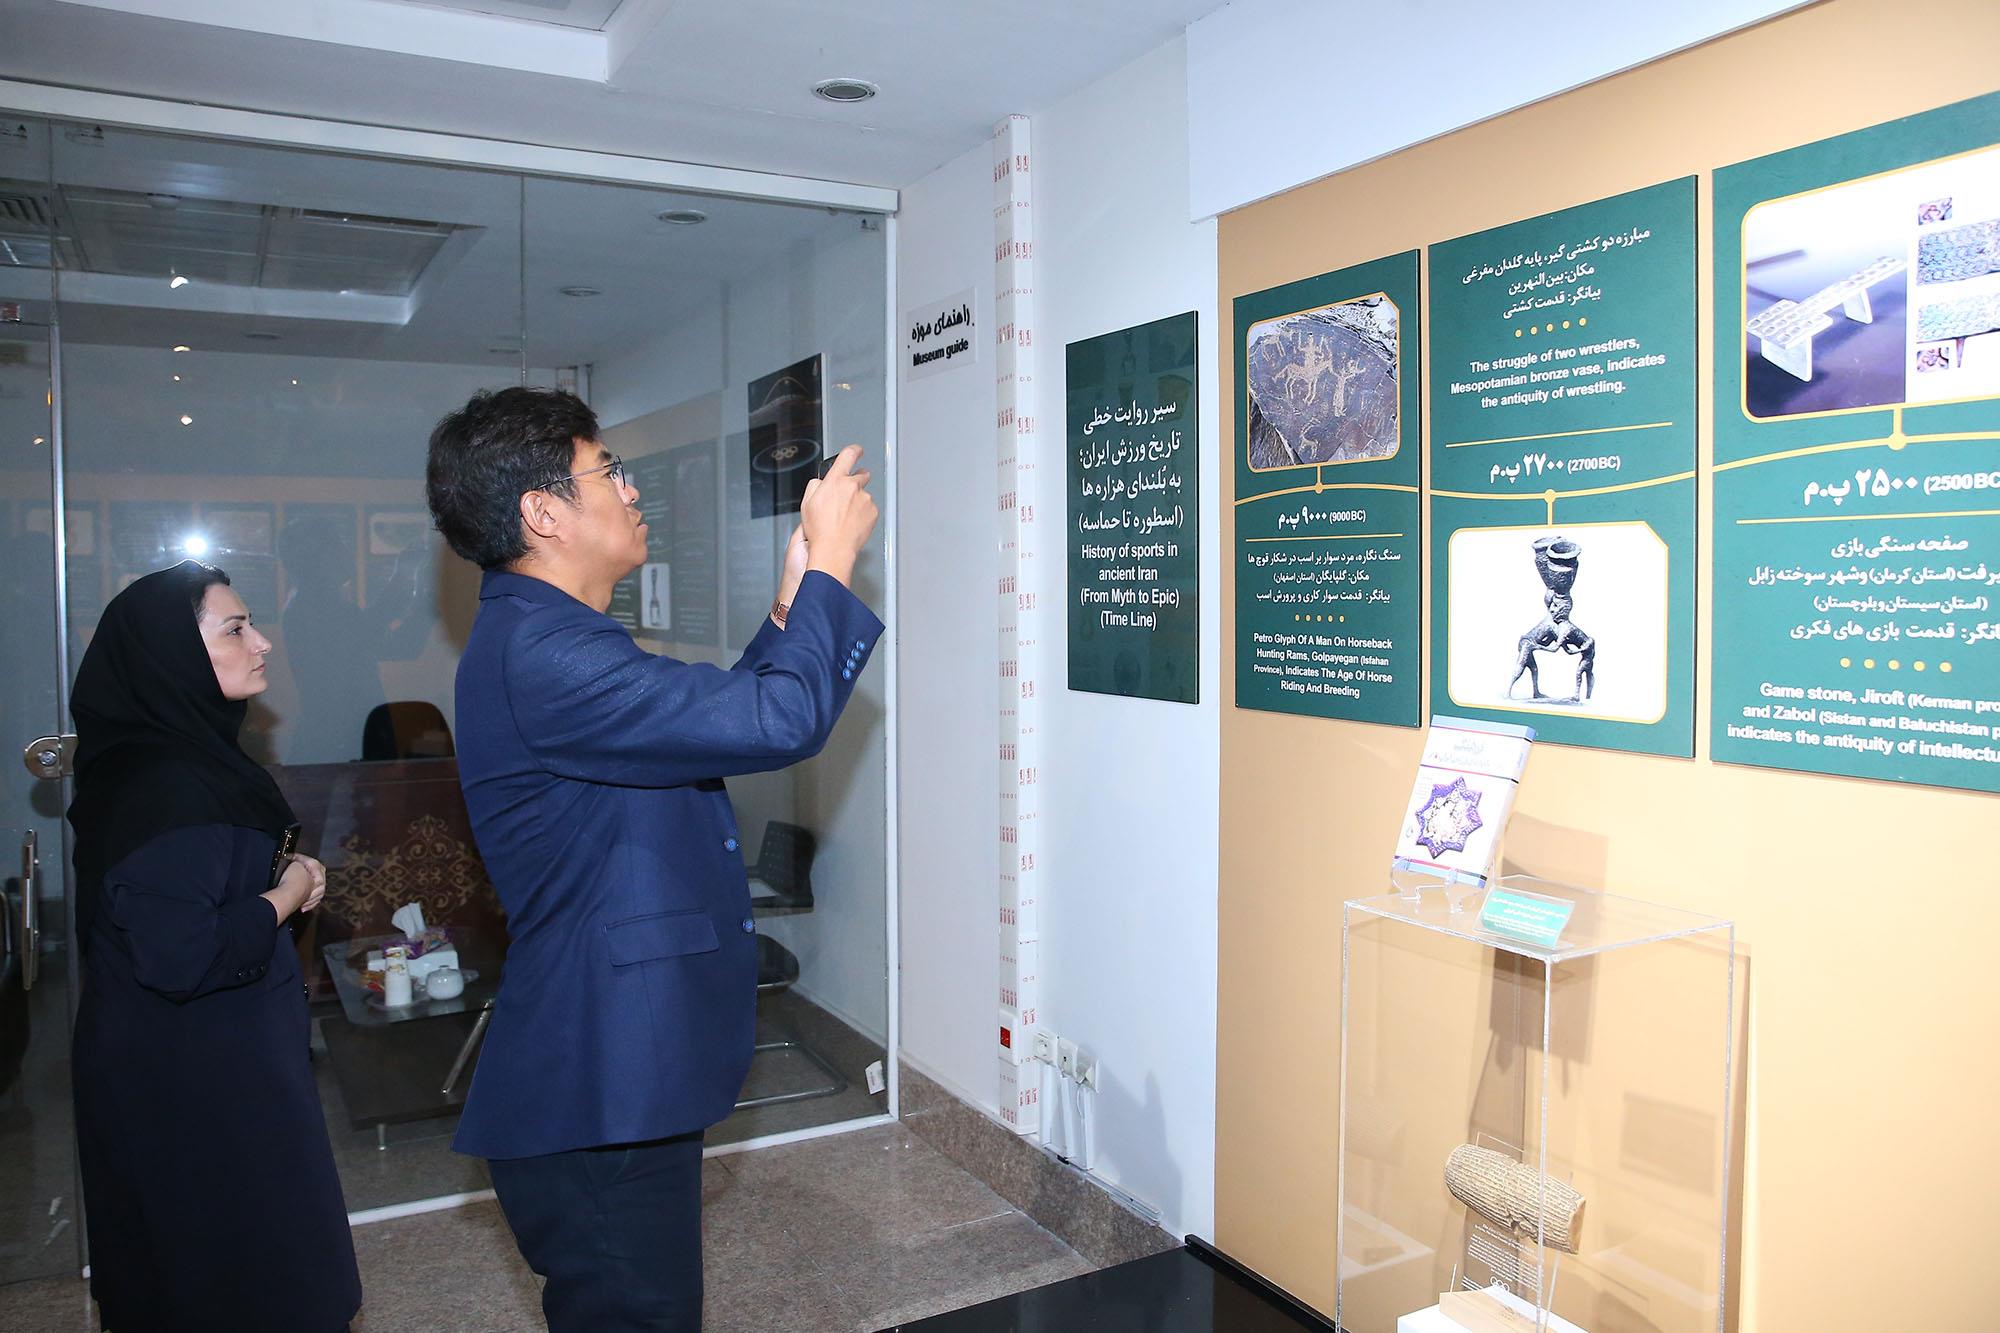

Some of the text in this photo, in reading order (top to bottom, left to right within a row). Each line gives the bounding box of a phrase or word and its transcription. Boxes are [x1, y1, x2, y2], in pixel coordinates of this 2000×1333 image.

[1601, 235, 1615, 251] دو
[1616, 227, 1650, 248] مبارزه
[1566, 236, 1600, 260] کشتی
[1494, 255, 1523, 276] گلدان
[1524, 251, 1542, 267] پایه
[1462, 264, 1494, 284] مفرغی
[1503, 297, 1534, 319] کشتی
[1534, 291, 1565, 308] قدمت
[934, 304, 970, 335] راهنمای
[912, 322, 931, 342] موزه
[913, 338, 968, 366] Museum guide
[1470, 338, 1640, 373] The struggle of two wrestlers,
[1450, 354, 1666, 395] Mesopotamian bronze vase, indicates
[1481, 380, 1626, 408] the antiquity of wrestling.
[1083, 400, 1176, 435] سیر روایت خطی
[1111, 439, 1145, 465] ورزش
[1148, 430, 1181, 460] تاریخ
[1169, 473, 1181, 493] به
[1122, 508, 1132, 528] تا
[1081, 541, 1178, 562] History of sports in
[1378, 548, 1401, 560] سنگ
[1830, 534, 1968, 558] صفحه سنگی بازی
[1255, 552, 1269, 567] قوچ
[1269, 552, 1287, 566] شکار
[1288, 554, 1297, 565] در
[1297, 551, 1314, 565] اسب
[1322, 551, 1340, 565] سوار
[1340, 553, 1354, 564] مرد
[1099, 565, 1158, 581] ancient Iran
[1315, 569, 1347, 585] گلپایگان
[1748, 566, 1776, 586] زابل
[1776, 566, 1826, 585] سوخته
[1080, 588, 1180, 608] (From Myth to Epic)
[1256, 589, 1272, 602] اسب
[1272, 589, 1296, 603] پرورش
[1340, 589, 1363, 600] قدمت
[1100, 610, 1157, 631] (Time Line)
[1790, 619, 1831, 640] فکری
[1832, 620, 1864, 640] های
[1905, 622, 1955, 638] قدمت
[1253, 632, 1393, 649] Petro Glyph Of A Man On Horseback
[1865, 620, 1900, 642] بازی
[1256, 648, 1285, 661] Hunting
[1286, 650, 1310, 662] Rams,
[1311, 651, 1359, 665] Golpayegan
[1285, 665, 1320, 677] Indicates
[1320, 667, 1335, 678] The
[1337, 669, 1354, 682] Age
[1355, 670, 1366, 680] Of
[1367, 671, 1393, 683] Horse
[1280, 680, 1360, 699] Riding And Breeding
[1759, 682, 1804, 699] Game
[1807, 687, 1857, 704] stone,
[1860, 688, 1905, 705] Jiroft
[1908, 693, 1972, 710] (Kerman
[1742, 705, 1771, 719] and
[1773, 705, 1816, 722] Zabol
[1819, 710, 1866, 726] (Sistan
[1868, 716, 1896, 729] and
[1899, 716, 1989, 737] Baluchistan
[1727, 724, 1792, 743] indicates
[1795, 730, 1820, 745] the
[1823, 733, 1894, 755] antiquity
[1897, 740, 1916, 754] of
